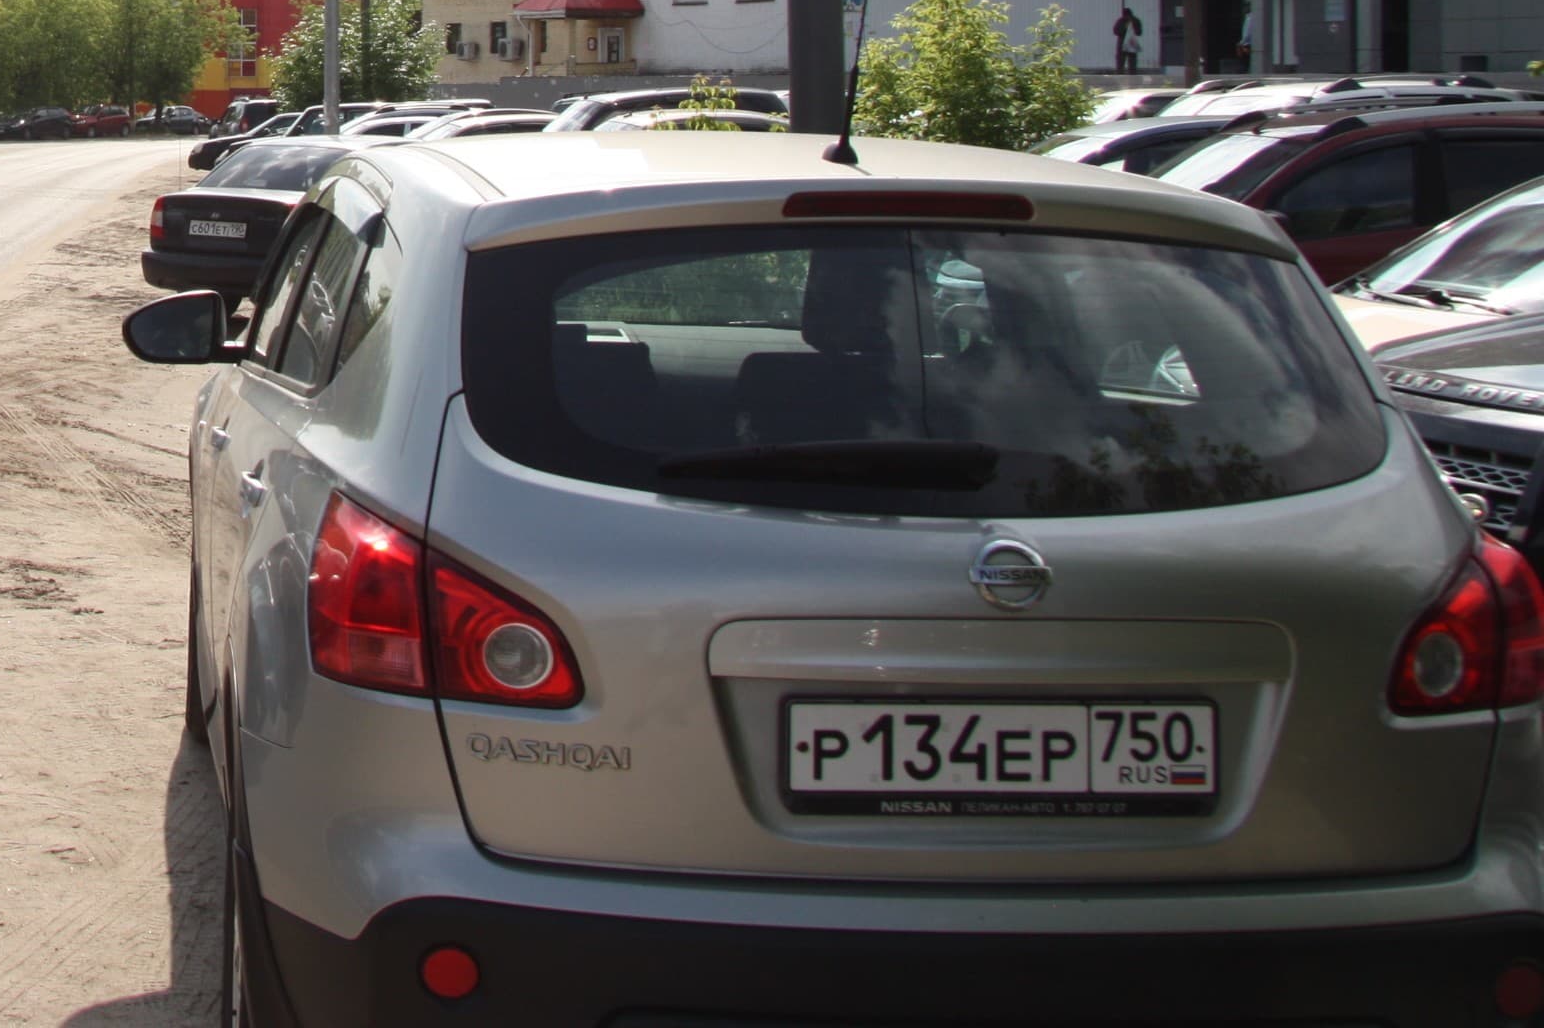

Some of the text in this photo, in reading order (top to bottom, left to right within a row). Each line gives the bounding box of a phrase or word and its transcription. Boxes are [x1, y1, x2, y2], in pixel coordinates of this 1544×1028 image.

[1383, 370, 1449, 393] LAND
[466, 732, 633, 771] QASHQAI
[812, 710, 1195, 782] Р134ЕР 750
[1118, 766, 1169, 785] RUS
[880, 800, 953, 813] NISSAN
